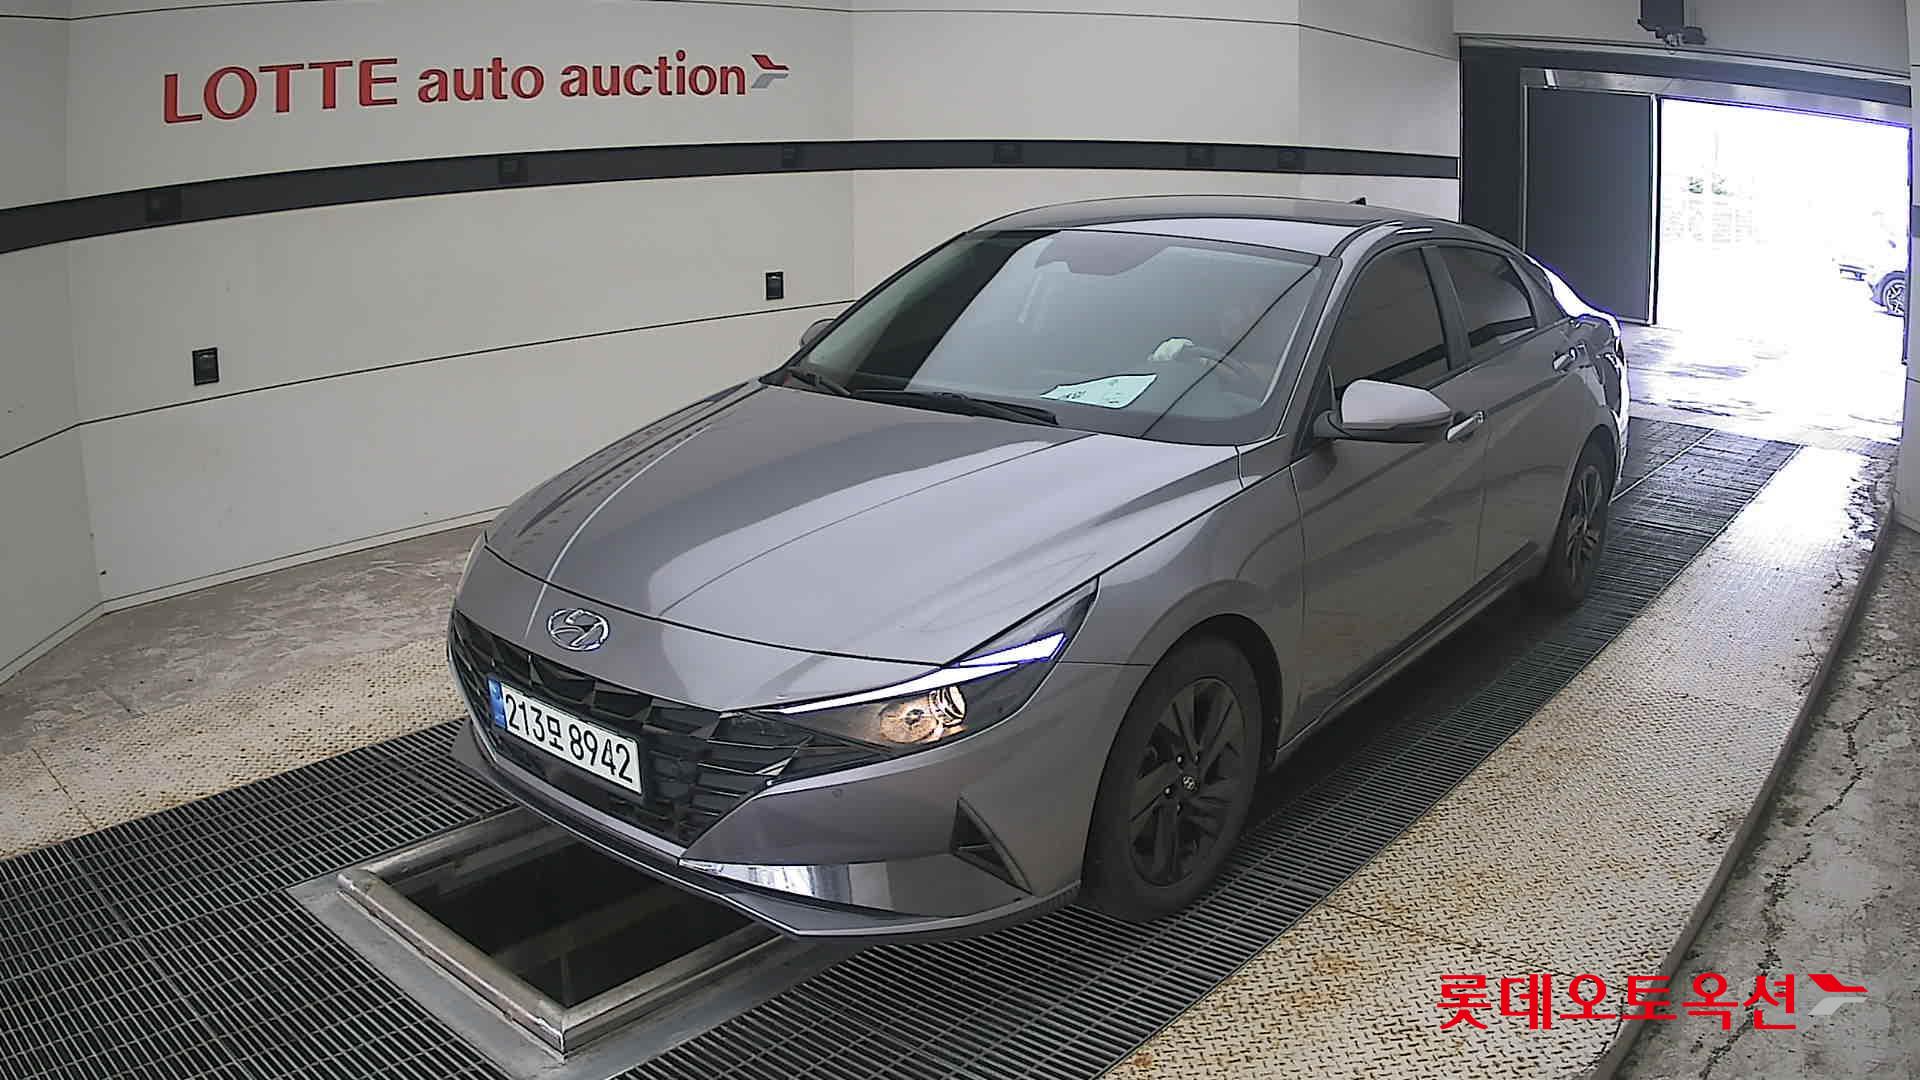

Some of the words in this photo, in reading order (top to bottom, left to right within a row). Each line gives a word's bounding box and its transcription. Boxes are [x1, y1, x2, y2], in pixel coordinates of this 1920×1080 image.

[164, 58, 398, 123] LOTTE
[418, 57, 545, 102] auto
[560, 50, 747, 98] auction
[568, 724, 633, 783] 8942
